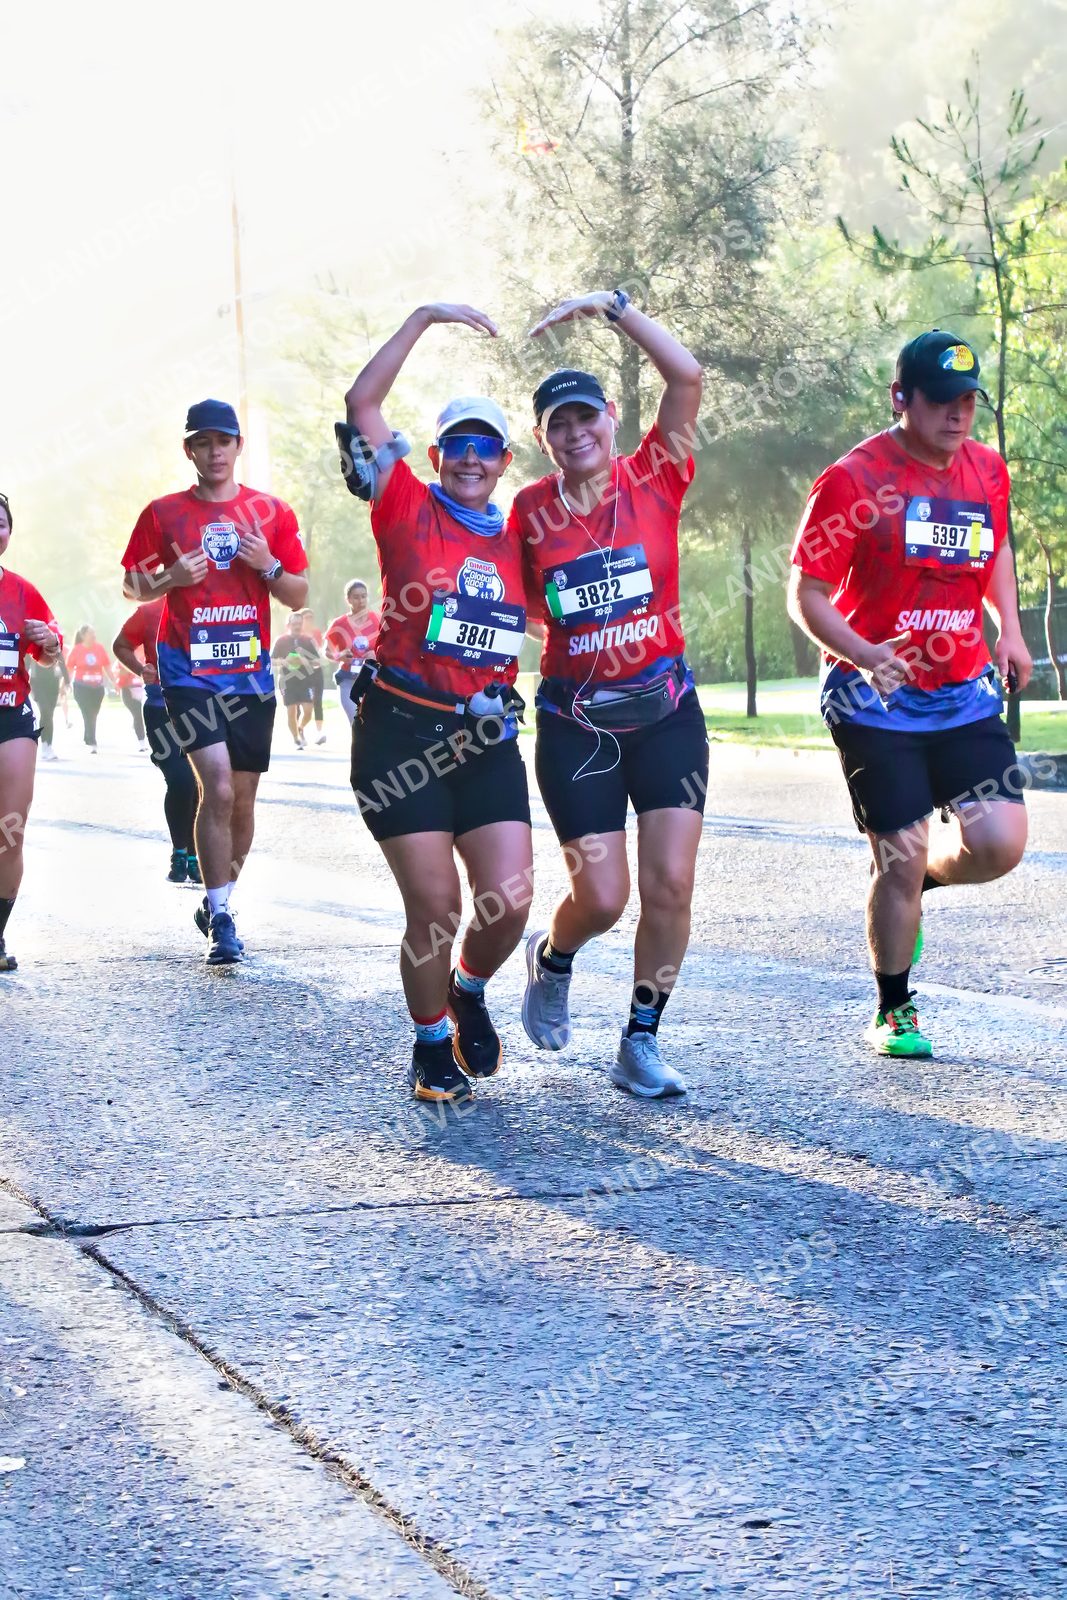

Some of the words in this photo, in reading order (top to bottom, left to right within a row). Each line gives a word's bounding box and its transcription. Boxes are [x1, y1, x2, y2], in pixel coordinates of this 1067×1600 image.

[551, 380, 578, 393] KIPRUN
[932, 525, 968, 547] 5397
[464, 576, 485, 588] Race
[469, 570, 493, 583] Global
[575, 578, 624, 609] 3822
[632, 606, 648, 616] 10K
[895, 608, 976, 632] SANTIAGO
[456, 622, 496, 650] 3841
[569, 615, 659, 657] SANTIAGO
[212, 642, 240, 658] 5641
